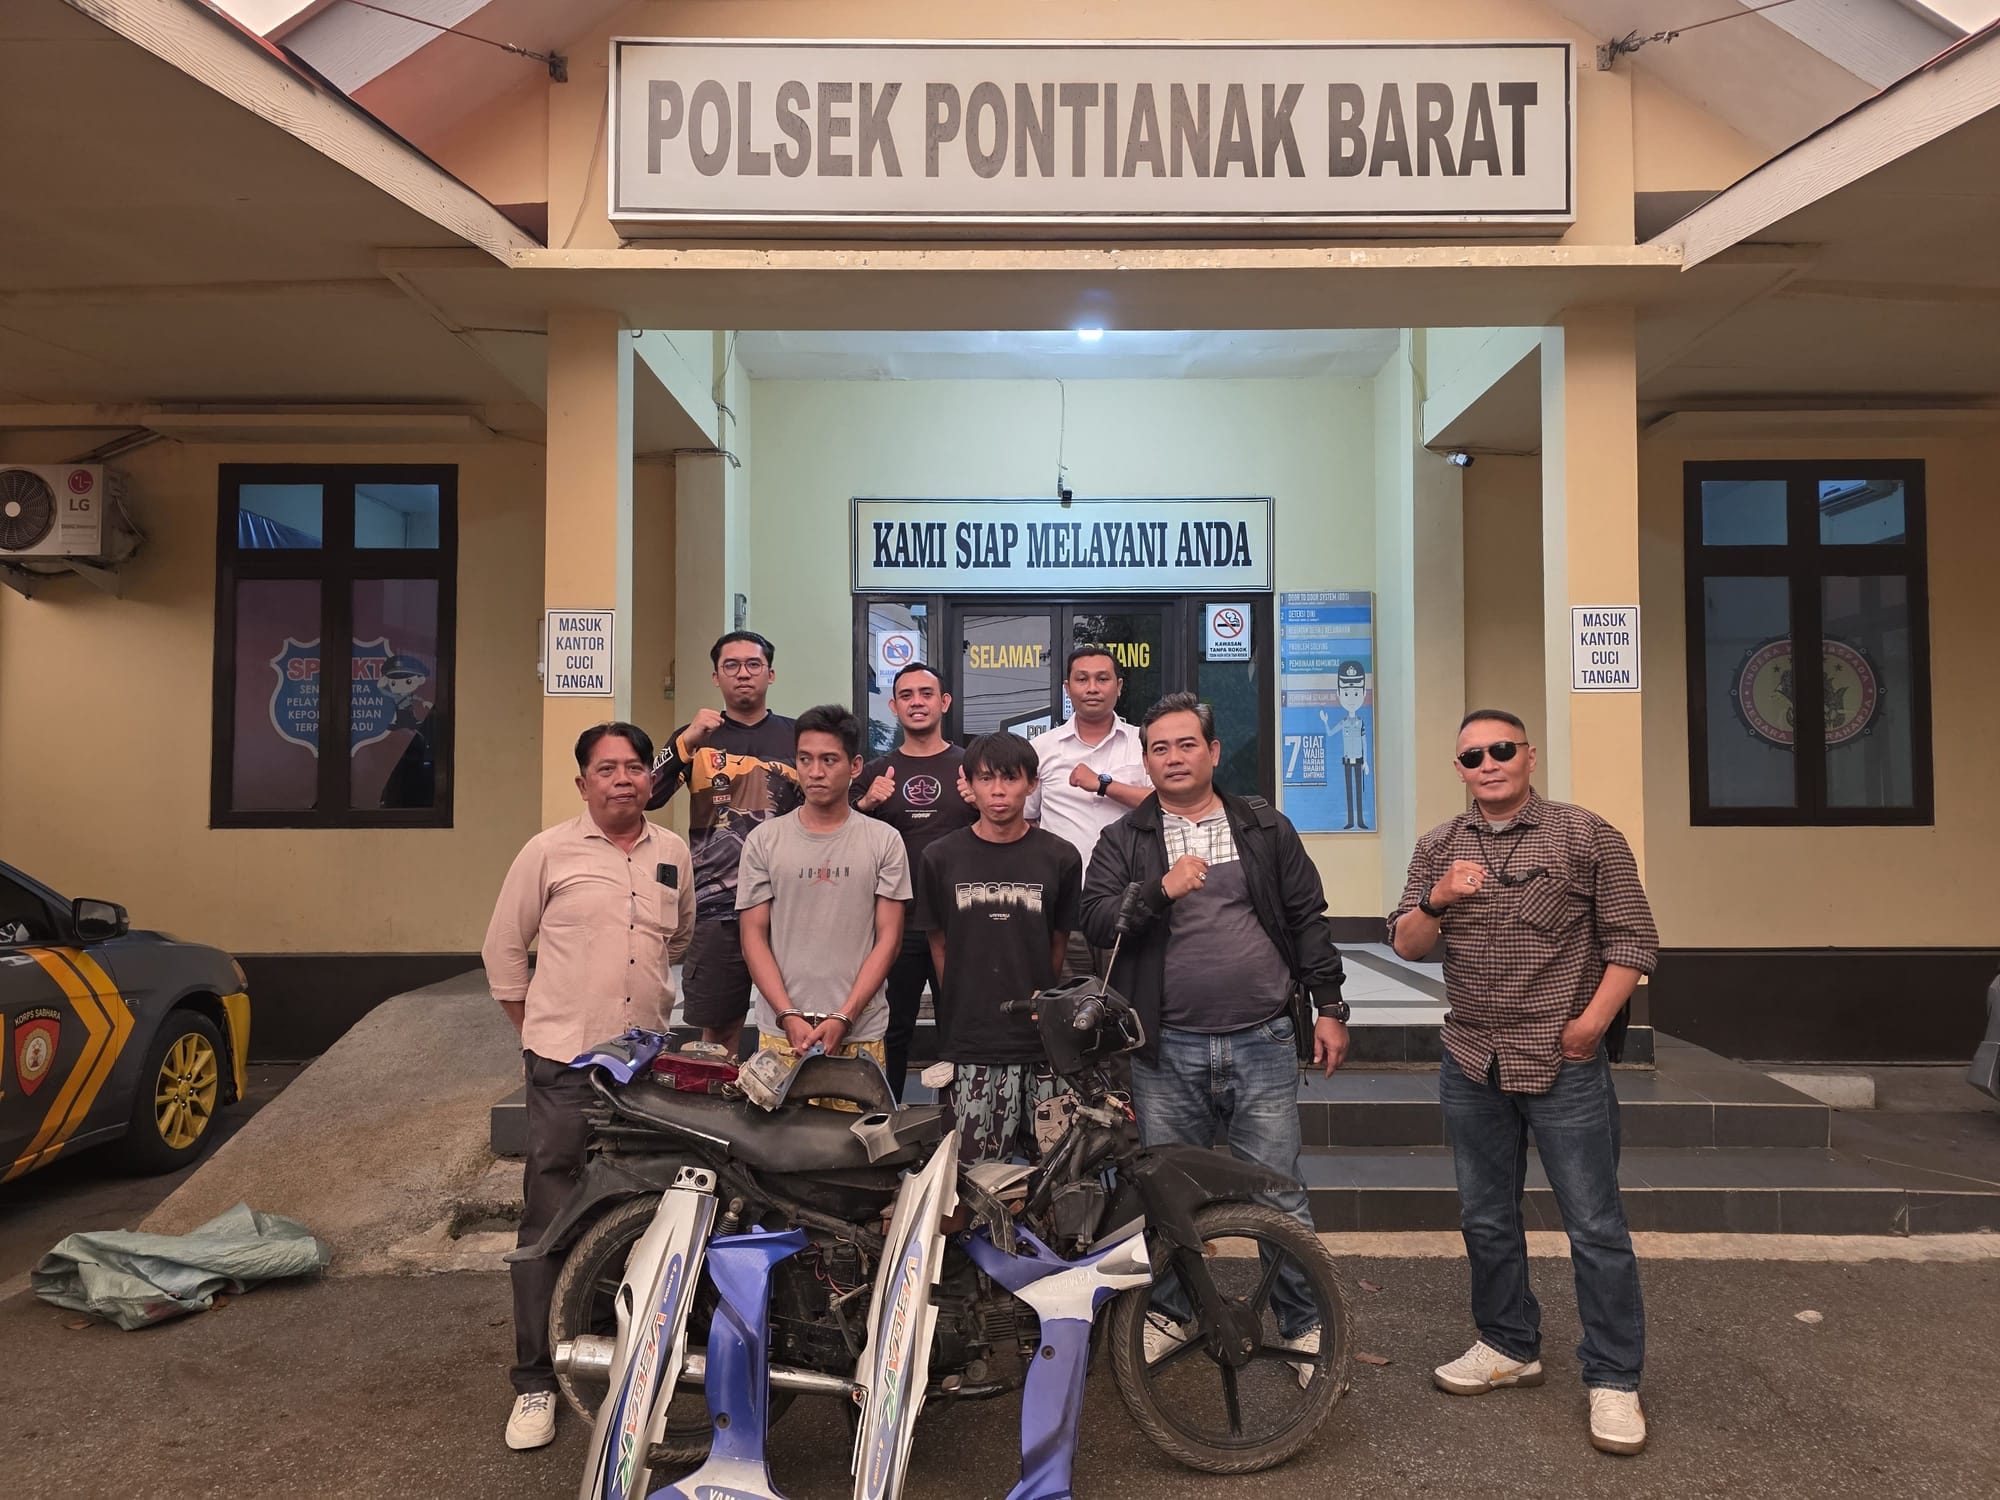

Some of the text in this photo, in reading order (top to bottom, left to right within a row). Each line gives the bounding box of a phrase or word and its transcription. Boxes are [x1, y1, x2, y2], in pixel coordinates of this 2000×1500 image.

[648, 79, 1538, 178] POLSEK PONTIANAK BARAT
[69, 498, 90, 512] LG
[872, 520, 1253, 570] KAMI SIAP MELAYANI ANDA
[559, 617, 602, 632] MASUK
[1583, 613, 1627, 627] MASUK
[555, 636, 605, 651] KANTOR
[1580, 632, 1629, 646] KANTOR
[566, 655, 594, 670] CUCI
[969, 643, 1151, 669] SELAMAT TANG
[1591, 651, 1619, 665] CUCI
[555, 674, 604, 689] TANGAN
[1581, 670, 1630, 684] TANGAN
[1302, 735, 1324, 749] GIAT
[1285, 735, 1301, 778] 7
[1303, 748, 1325, 759] WAJIB
[14, 1008, 61, 1026] KORPS SABHARA
